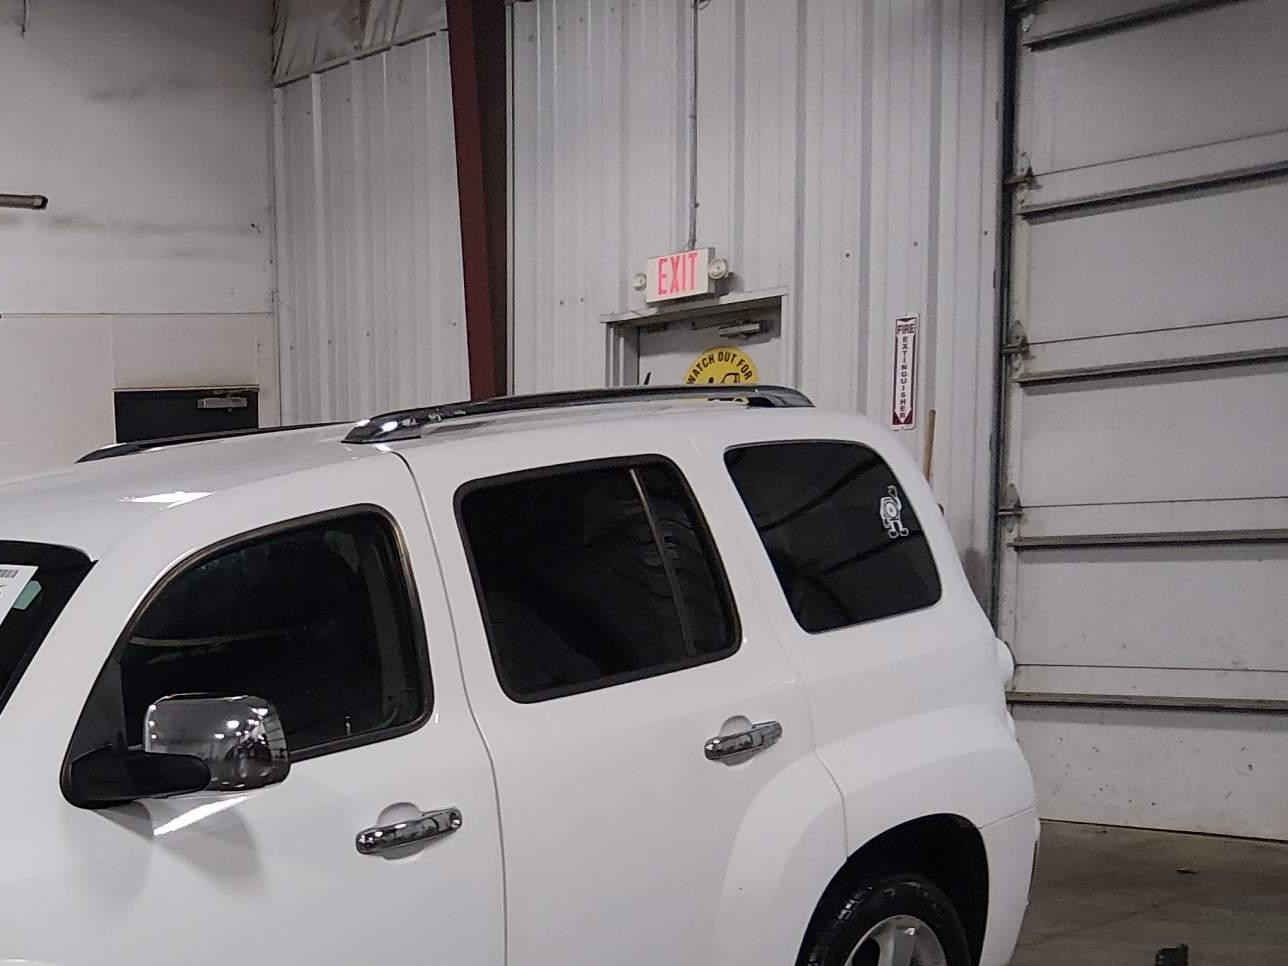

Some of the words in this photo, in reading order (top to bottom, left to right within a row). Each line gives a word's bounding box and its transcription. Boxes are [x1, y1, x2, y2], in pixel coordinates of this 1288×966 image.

[657, 252, 698, 295] EXIT
[897, 323, 915, 334] FIRE
[686, 353, 715, 385] WATCH
[717, 351, 738, 364] OUT
[736, 358, 753, 381] FOR
[899, 335, 909, 419] EXTINGUISHER
